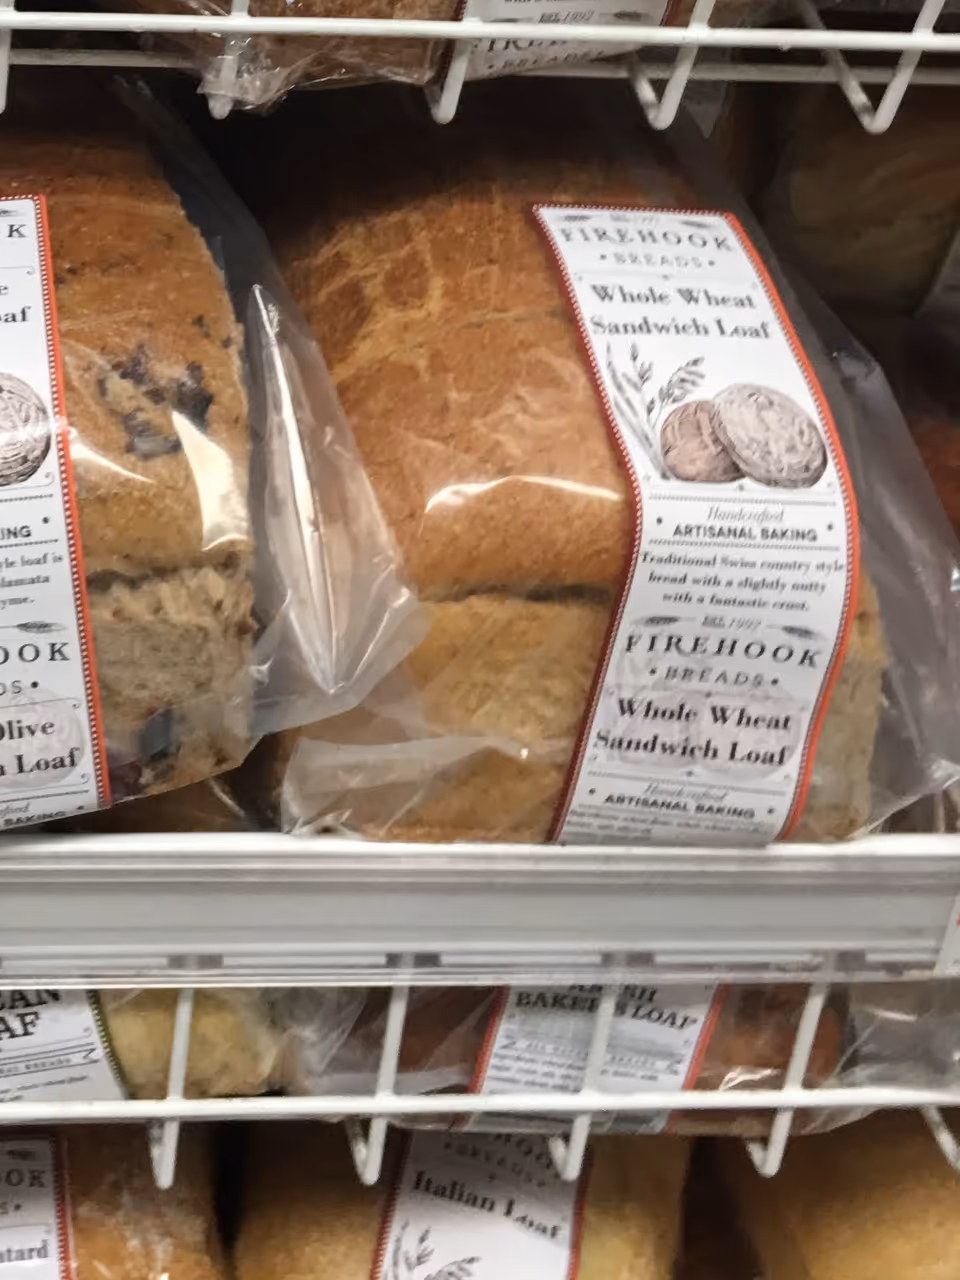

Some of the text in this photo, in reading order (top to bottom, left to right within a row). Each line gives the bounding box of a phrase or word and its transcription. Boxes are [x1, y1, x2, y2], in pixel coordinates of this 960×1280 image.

[560, 226, 733, 252] FIREHOOK
[590, 283, 757, 309] Whole Wheat
[590, 315, 771, 340] Sandwich Loaf
[672, 523, 818, 543] ARTISANAL BAKING
[625, 633, 824, 669] FIREHOOK
[664, 666, 763, 687] BREADS
[617, 697, 792, 730] Whole Wheat
[592, 728, 788, 766] Sandwich Loaf
[13, 747, 81, 774] Loaf
[413, 1170, 496, 1213] Italian
